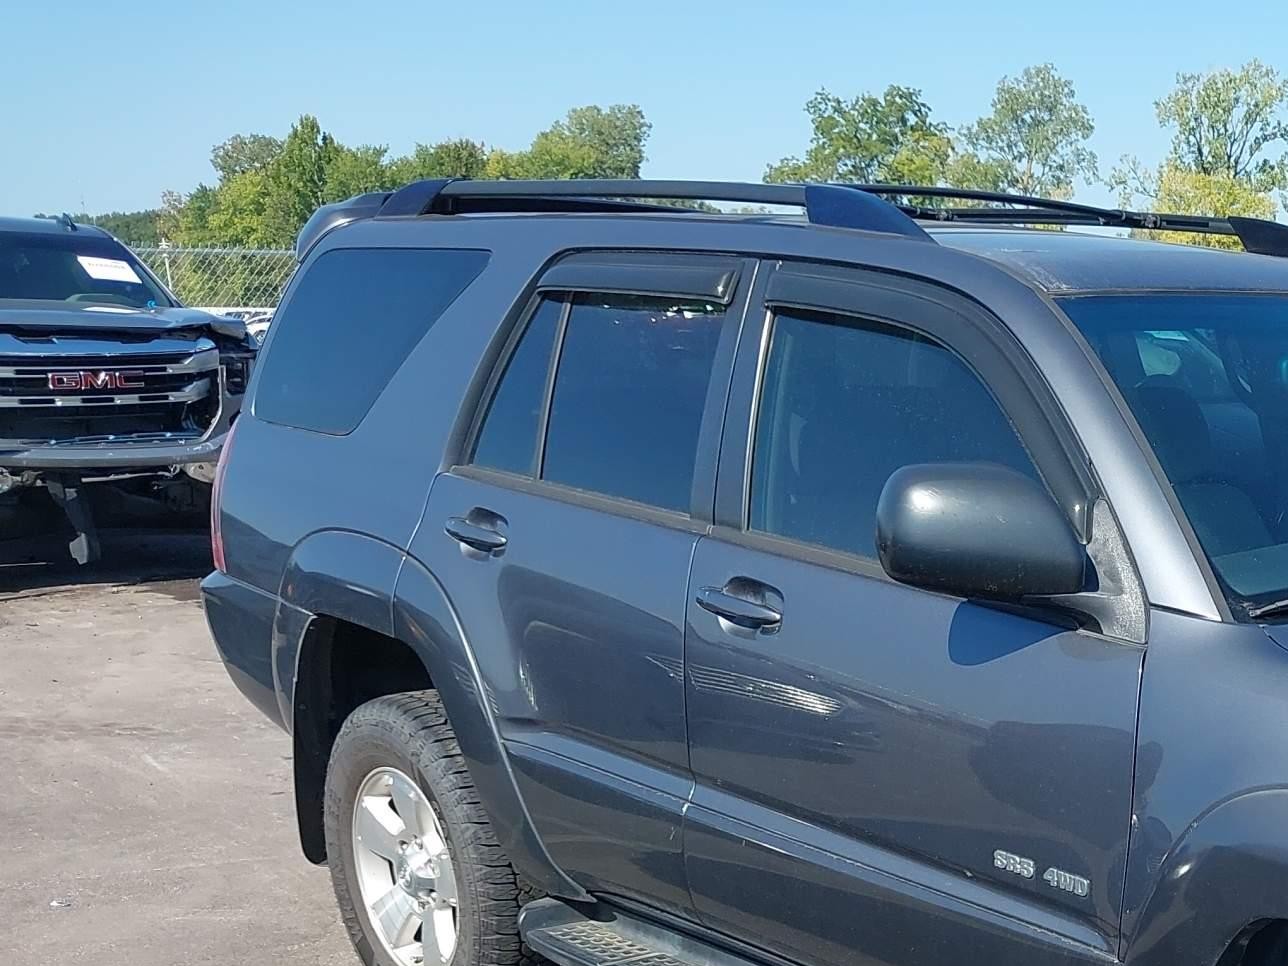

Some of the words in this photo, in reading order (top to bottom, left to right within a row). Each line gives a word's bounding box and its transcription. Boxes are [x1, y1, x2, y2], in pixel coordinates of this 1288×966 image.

[48, 370, 145, 390] GMC
[993, 849, 1036, 879] SR5
[1043, 867, 1090, 897] 4WD
